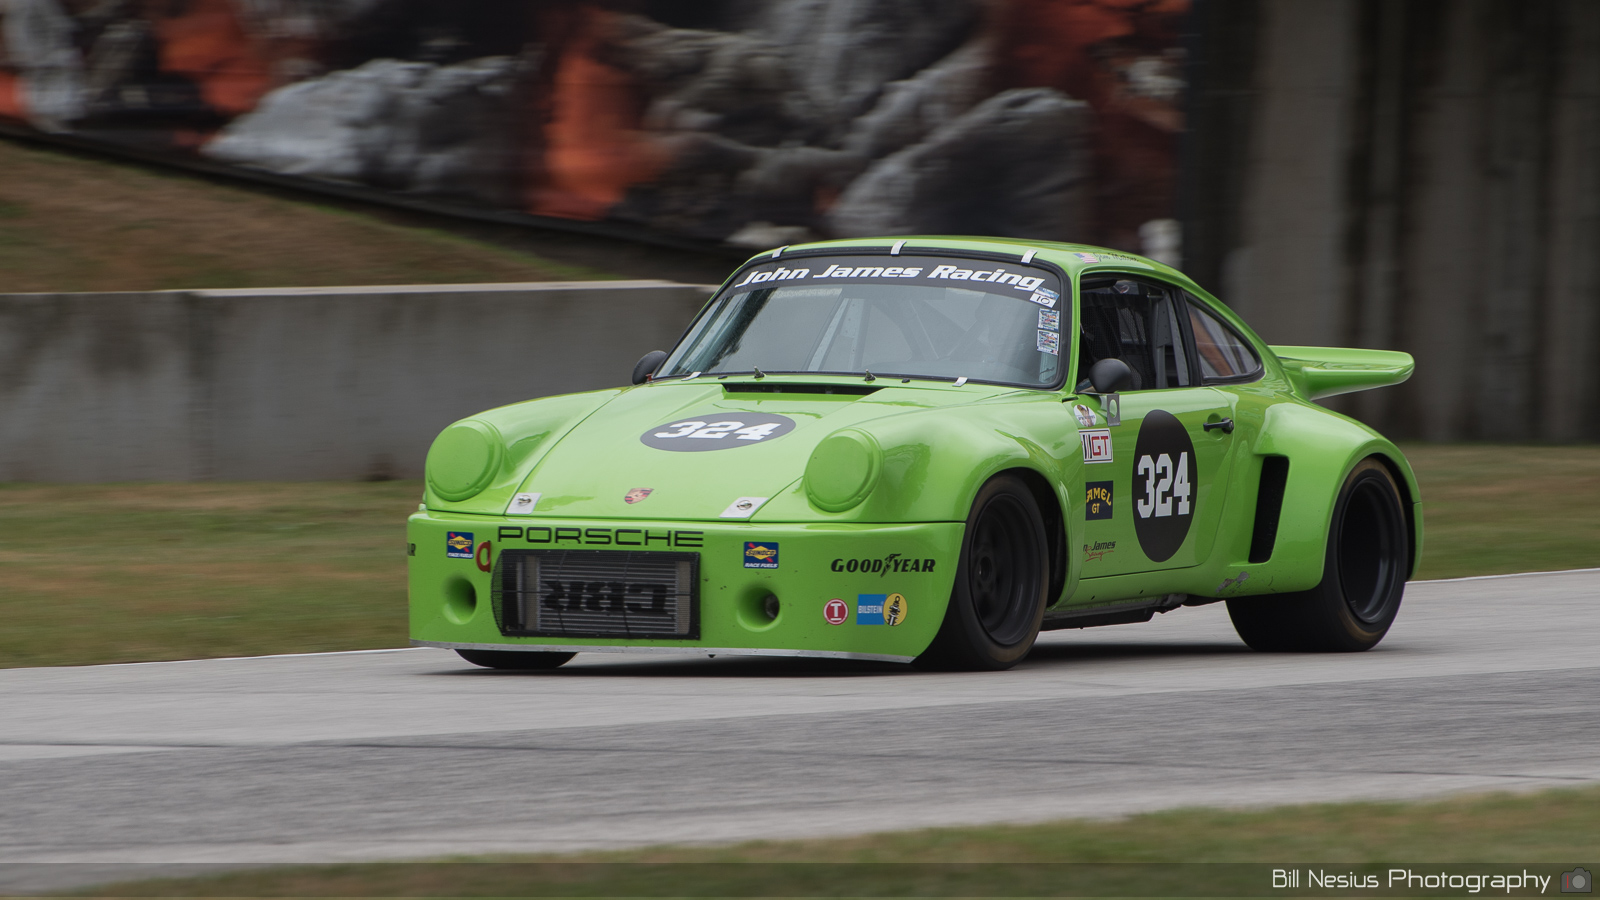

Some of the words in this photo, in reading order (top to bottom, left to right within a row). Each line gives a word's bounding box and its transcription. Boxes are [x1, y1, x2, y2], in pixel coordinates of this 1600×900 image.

[735, 266, 810, 288] John
[813, 264, 923, 279] James
[927, 264, 1045, 291] Racing
[654, 421, 782, 441] 324
[1137, 451, 1191, 519] 324
[1086, 487, 1112, 507] AMEL
[1091, 502, 1100, 514] GT
[498, 526, 704, 548] PORSCHE
[1091, 540, 1117, 551] James
[830, 553, 936, 578] GOODYEAR
[858, 605, 883, 614] BILSTEIN
